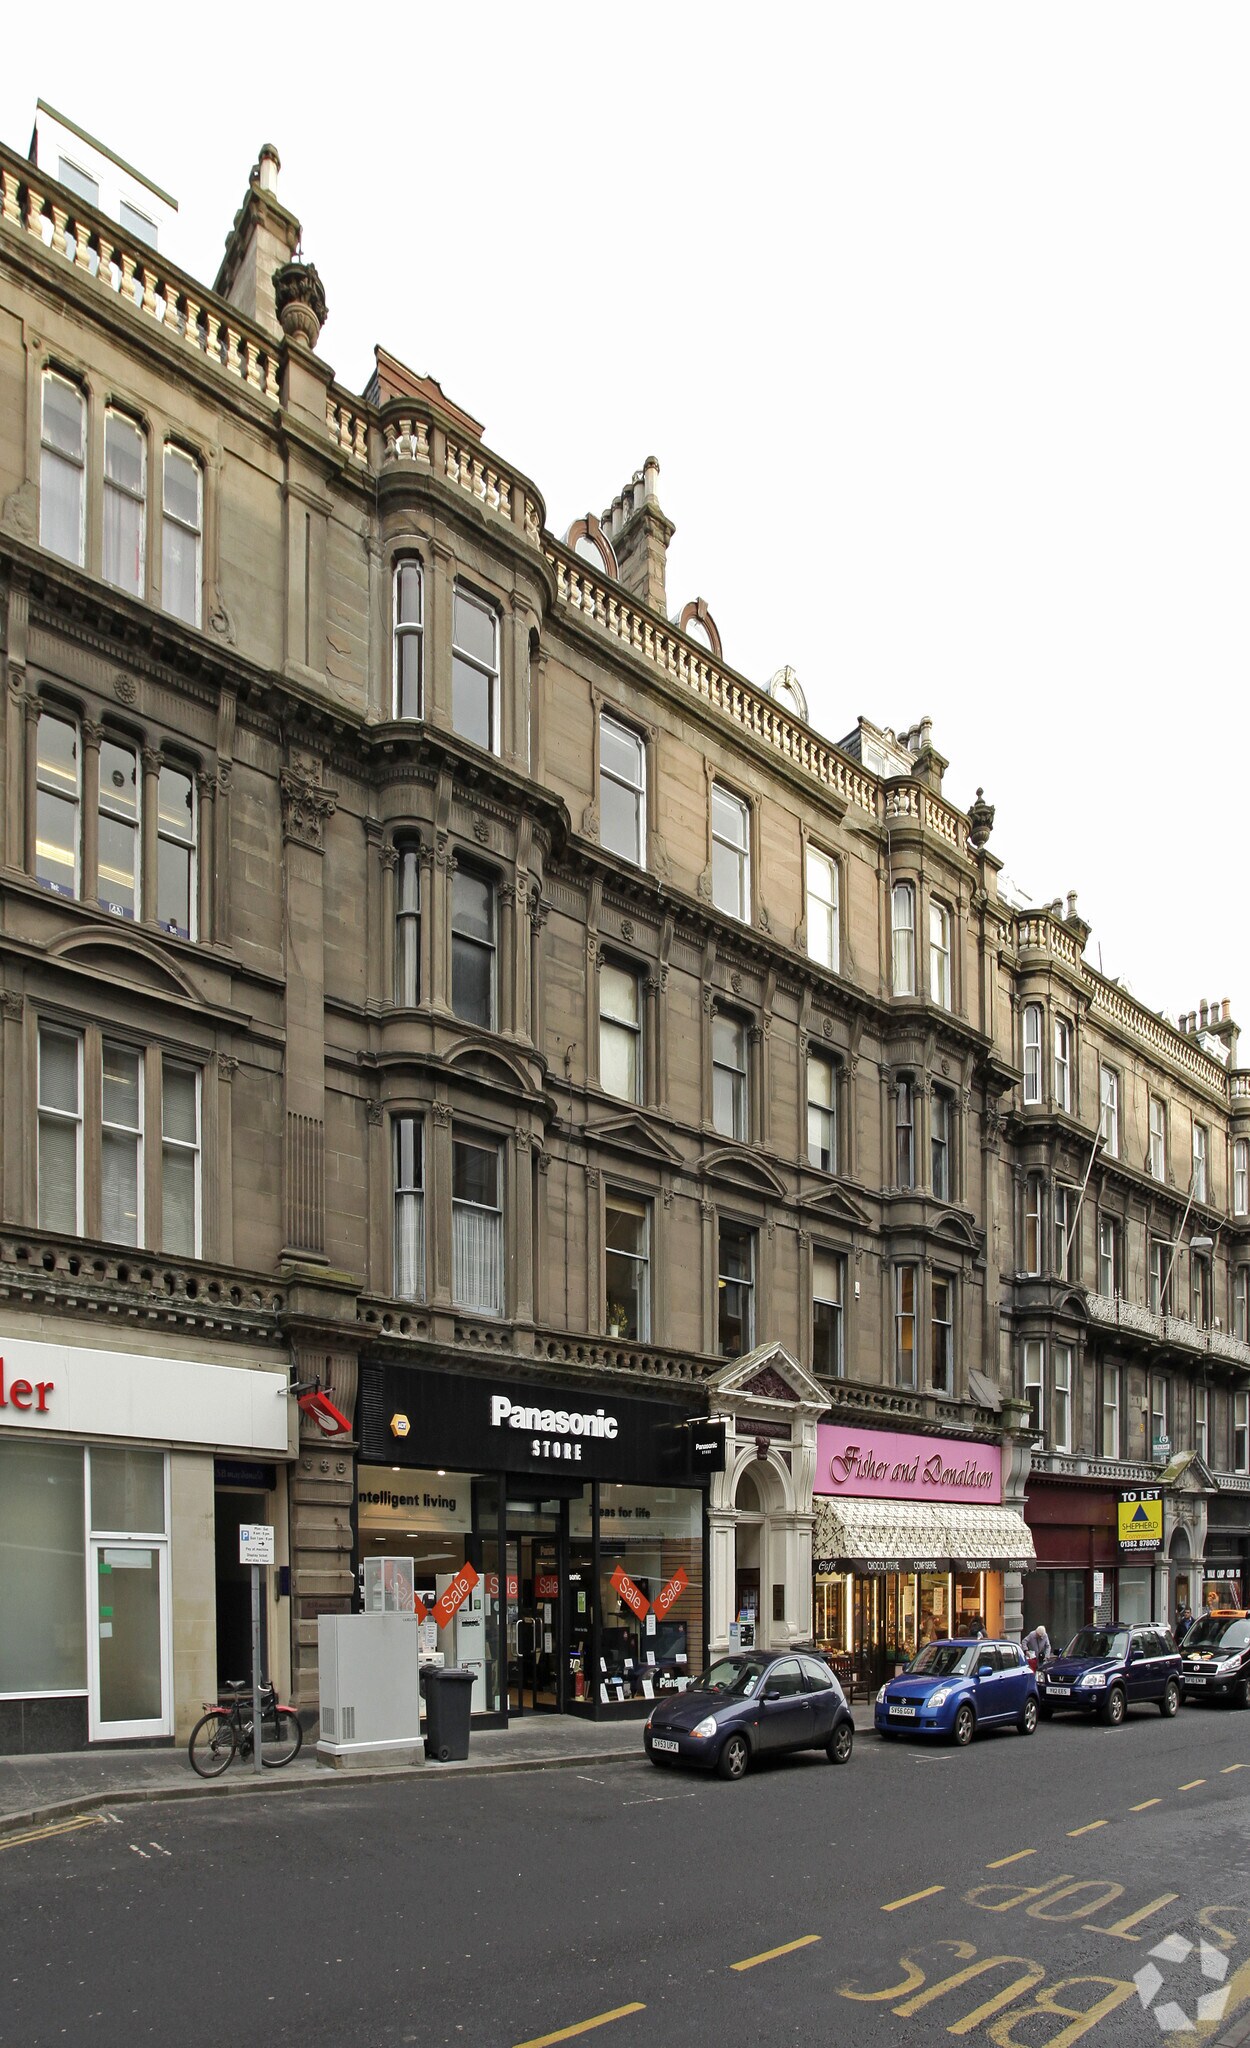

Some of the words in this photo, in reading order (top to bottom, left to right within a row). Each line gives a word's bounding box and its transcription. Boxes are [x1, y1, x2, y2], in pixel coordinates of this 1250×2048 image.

[490, 1394, 618, 1440] Panasonic
[532, 1439, 582, 1461] STORE
[695, 1441, 718, 1451] Panasonic
[829, 1445, 891, 1484] Fisher
[889, 1454, 921, 1483] and
[921, 1453, 994, 1489] Donaldson
[358, 1490, 420, 1508] ntelligent
[423, 1493, 457, 1511] living
[1121, 1492, 1137, 1502] TO
[1140, 1490, 1160, 1501] LET
[618, 1506, 633, 1518] for
[635, 1507, 651, 1519] life
[1121, 1521, 1159, 1531] SHEPHERD
[242, 1531, 249, 1540] P
[1139, 1539, 1161, 1547] 878005
[818, 1560, 836, 1572] Café
[489, 1576, 518, 1595] Sle
[539, 1577, 559, 1594] Sale
[619, 1576, 641, 1609] Sale
[659, 1580, 682, 1609] Sale
[441, 1578, 469, 1614] Sale
[654, 1739, 667, 1749] SY53
[666, 1741, 677, 1751] UPX
[835, 1939, 1138, 2048] BUS
